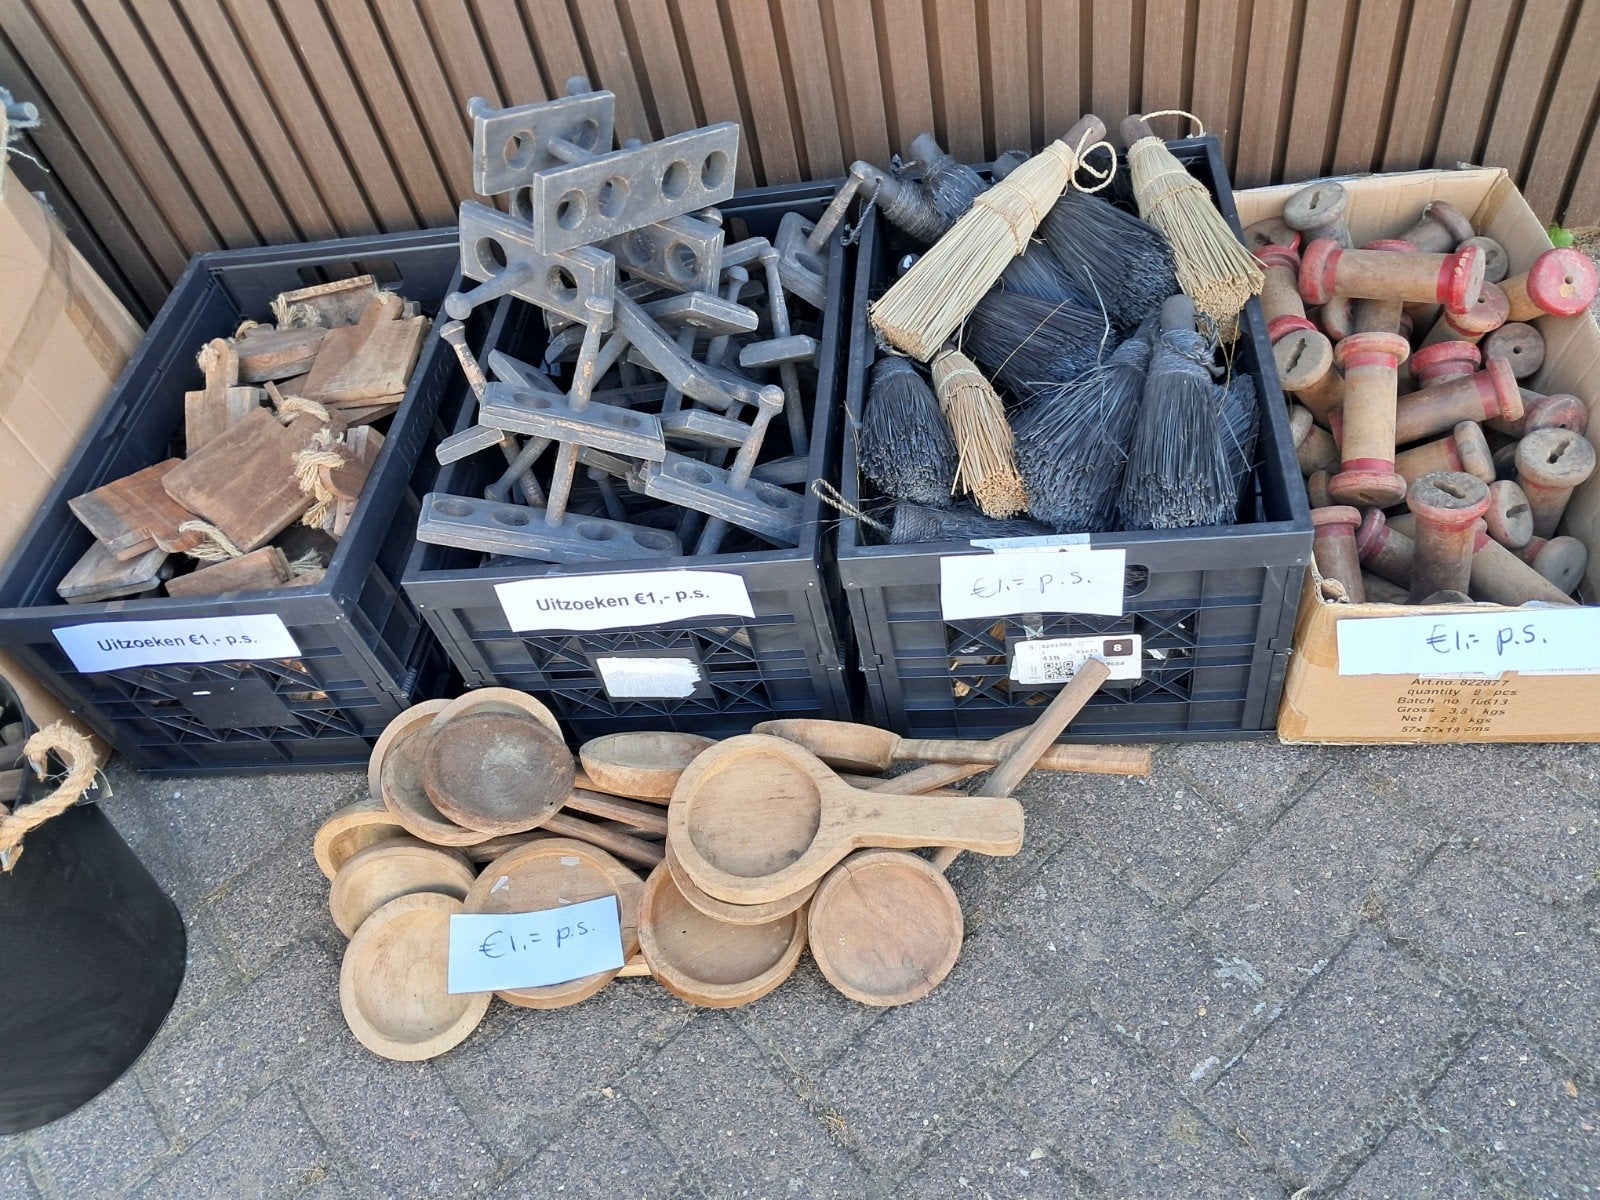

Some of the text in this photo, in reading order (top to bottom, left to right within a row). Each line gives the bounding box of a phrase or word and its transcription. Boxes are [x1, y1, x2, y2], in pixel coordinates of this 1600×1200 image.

[535, 588, 710, 611] Uitzoeken €1,- p.s.
[97, 632, 258, 652] Uitzoeken €1,- p.s.
[1496, 624, 1548, 656] p.s.
[1113, 643, 1123, 652] 8
[1411, 678, 1456, 686] Art.no.
[1407, 688, 1461, 697] quantity
[1493, 689, 1518, 697] pcs
[1482, 708, 1506, 716] kgs
[1468, 717, 1492, 725] kgs
[557, 921, 595, 948] p.s.
